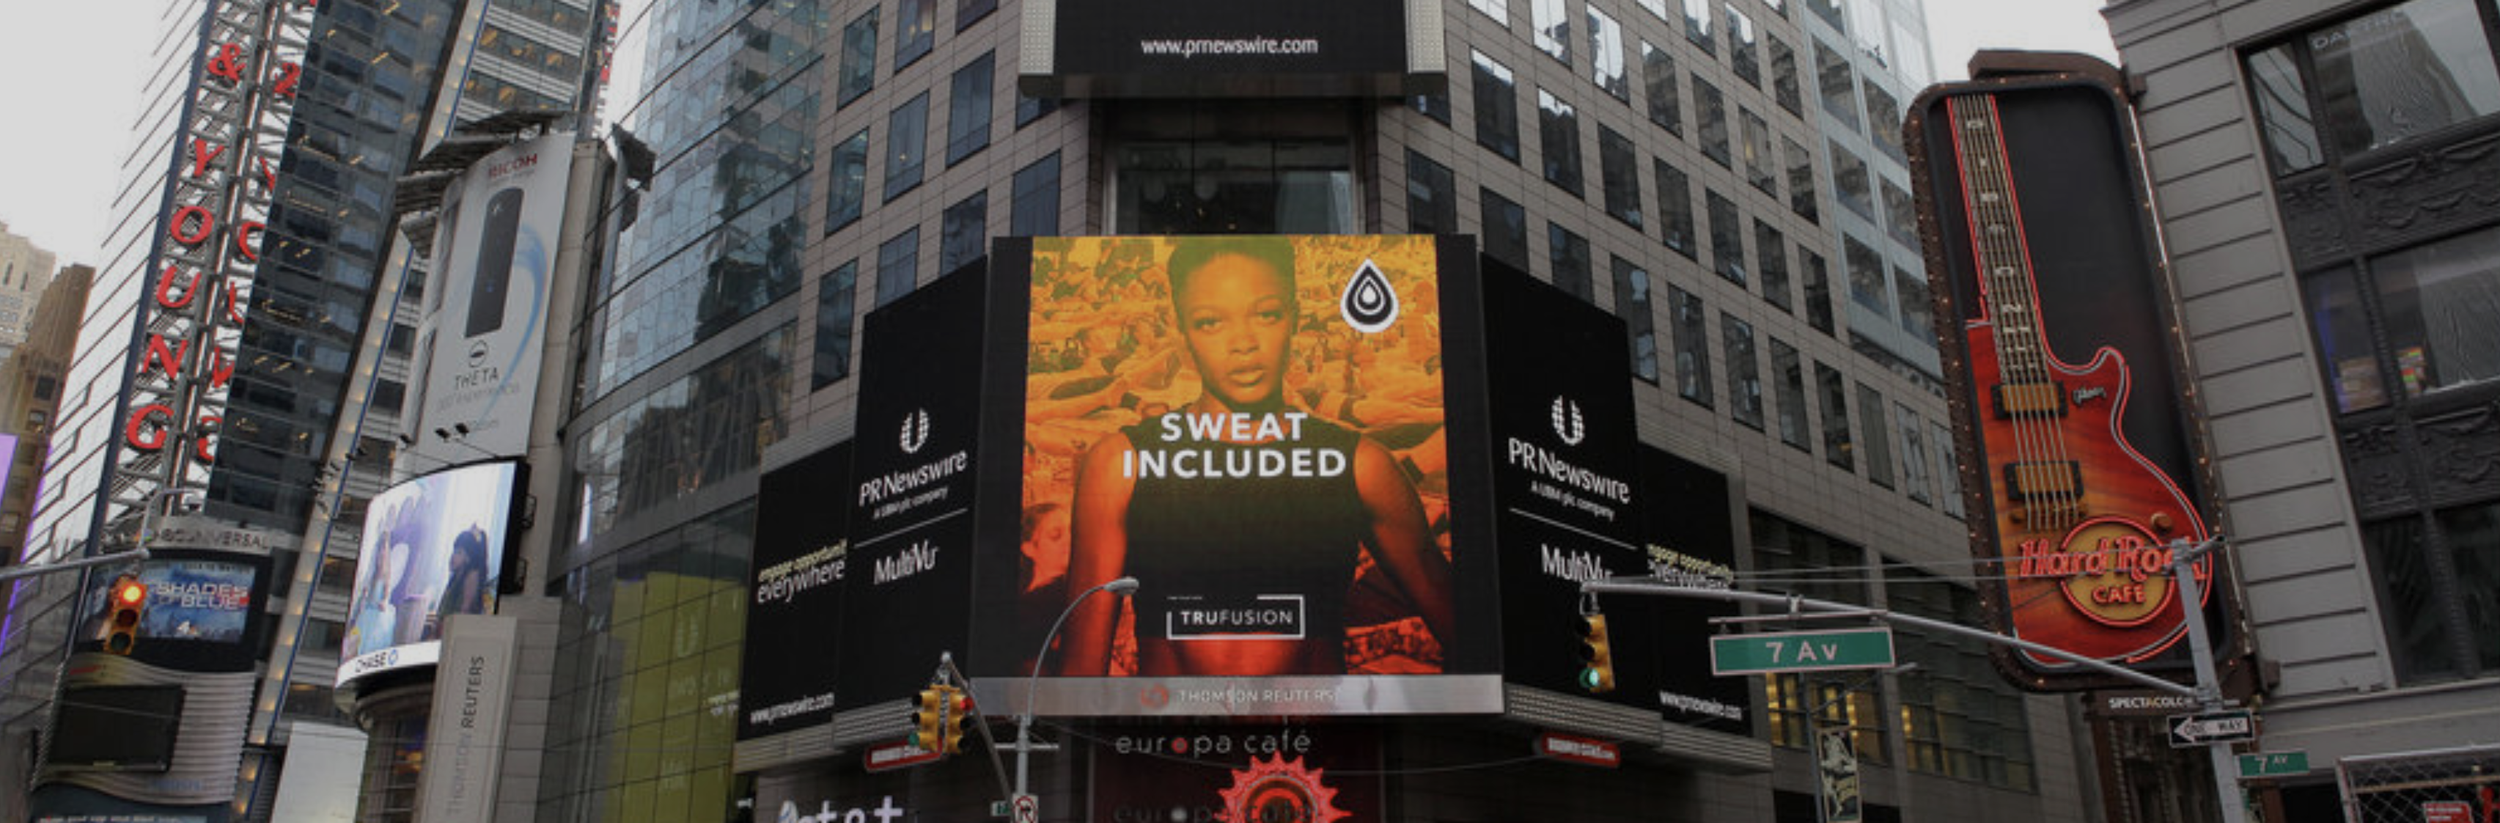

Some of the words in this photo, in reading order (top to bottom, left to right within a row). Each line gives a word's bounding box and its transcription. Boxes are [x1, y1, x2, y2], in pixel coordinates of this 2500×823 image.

[1141, 36, 1318, 58] www.prnewswire.com
[208, 43, 246, 84] &
[488, 152, 538, 180] RICOH
[454, 366, 500, 391] THETA
[1160, 412, 1309, 443] SWEAT
[1123, 449, 1347, 479] INCLUDED
[1508, 437, 1537, 473] PR
[1539, 447, 1631, 505] Newswire
[859, 476, 883, 507] PR
[884, 449, 968, 499] Newswire
[2018, 535, 2110, 578] Hard
[2114, 535, 2209, 582] Roc
[757, 558, 846, 604] everywhere
[2092, 584, 2147, 605] CAFE
[1180, 609, 1294, 626] TRUFUSION
[1766, 641, 1783, 663] 7
[1796, 639, 1838, 662] Av
[461, 655, 486, 729] REUTERS
[1263, 688, 1336, 703] REUTERS
[2183, 721, 2207, 736] ONE
[2217, 718, 2244, 732] WAY
[1244, 728, 1312, 755] café
[2254, 755, 2268, 775] 7
